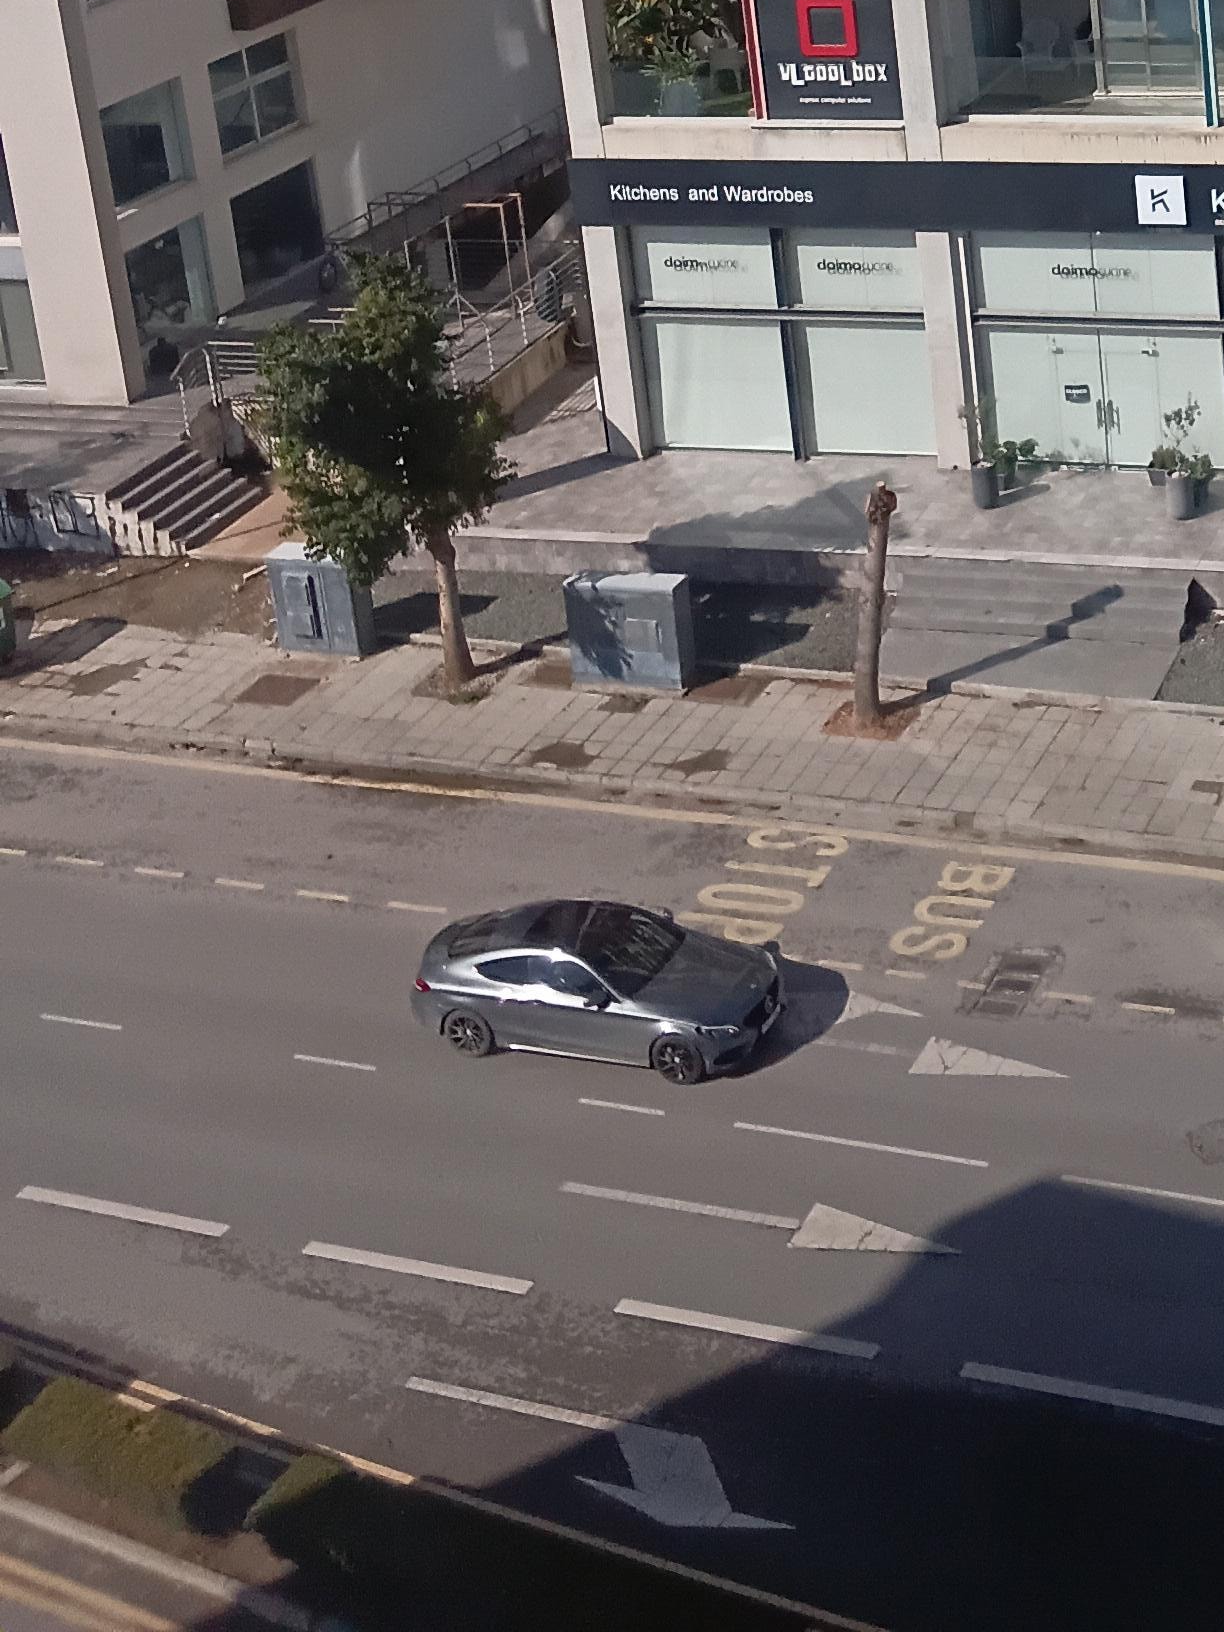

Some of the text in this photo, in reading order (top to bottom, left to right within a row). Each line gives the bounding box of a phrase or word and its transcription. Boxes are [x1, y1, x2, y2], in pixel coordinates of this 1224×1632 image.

[610, 184, 814, 203] Kitchens and Wardrobes
[1150, 188, 1171, 213] K
[676, 828, 850, 945] STOP
[889, 861, 1016, 960] BUS
